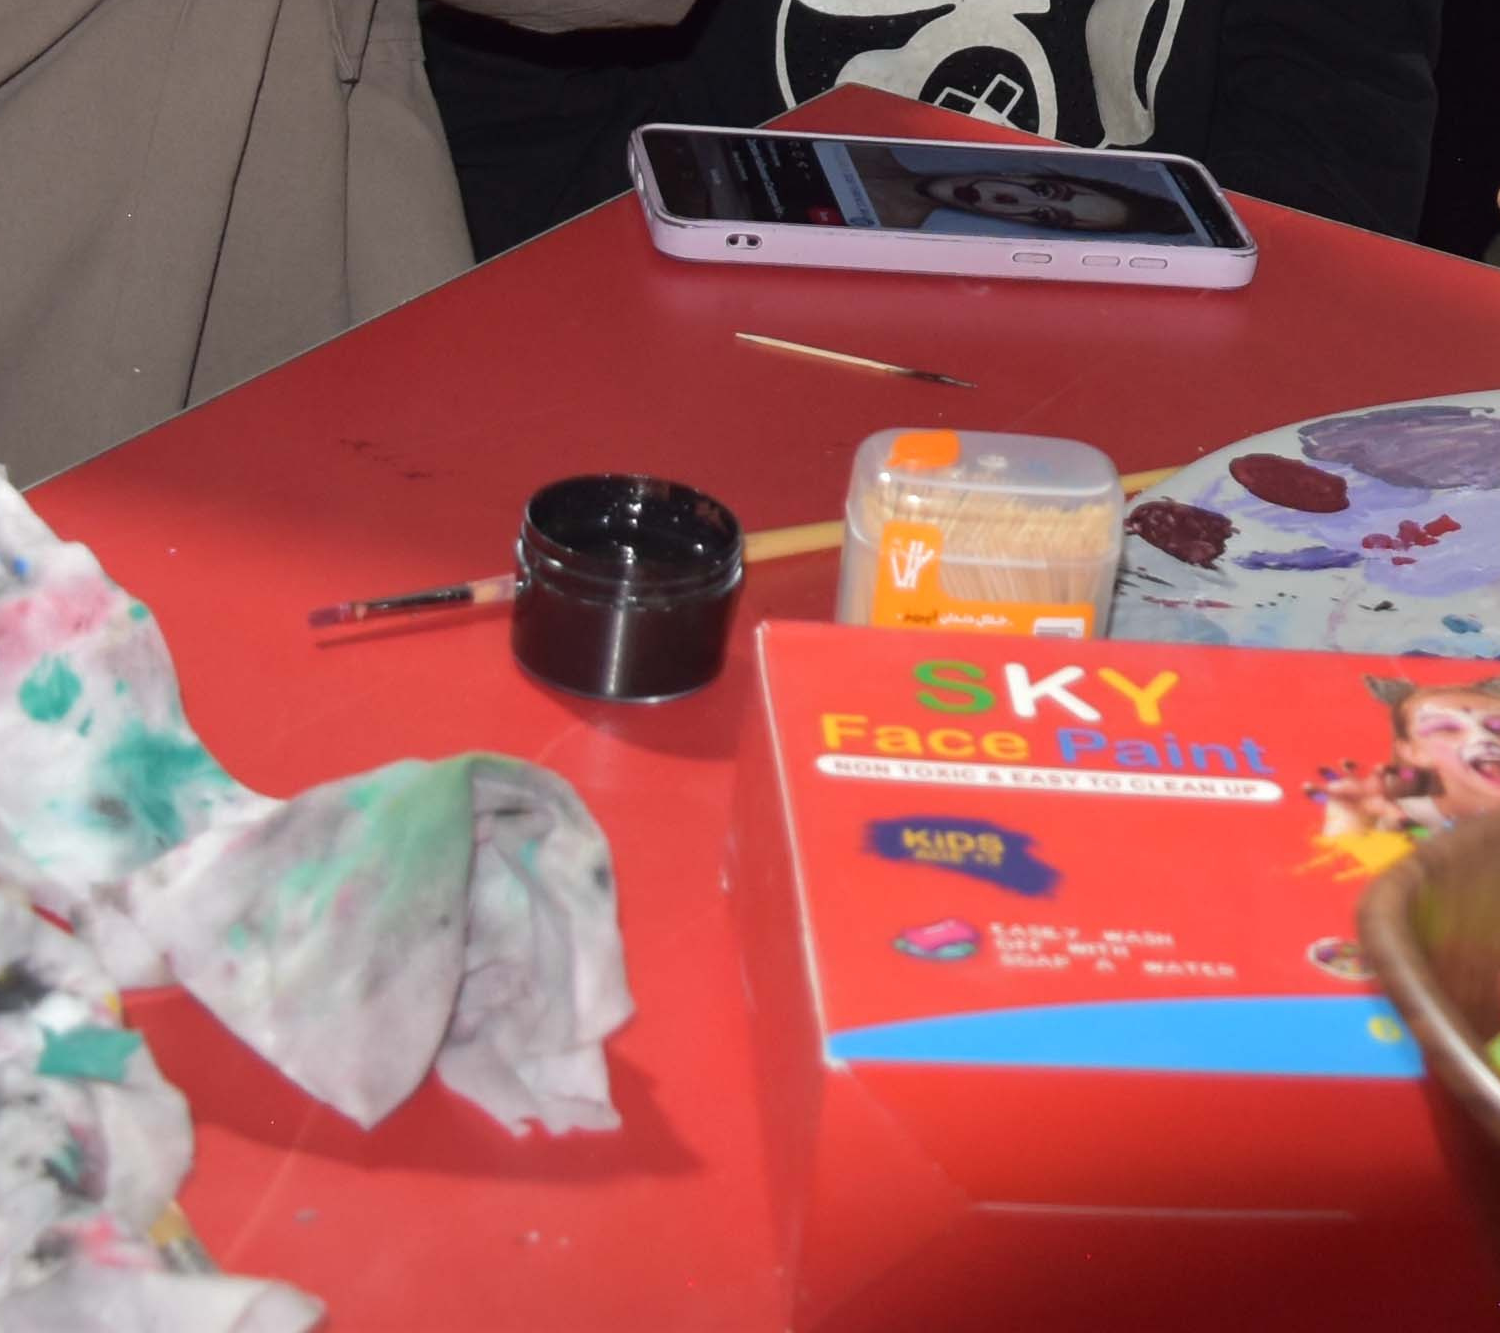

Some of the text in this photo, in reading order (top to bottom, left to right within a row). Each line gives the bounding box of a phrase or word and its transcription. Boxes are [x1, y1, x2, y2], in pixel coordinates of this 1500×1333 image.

[912, 660, 1179, 726] SKY
[820, 713, 1275, 775] Face Paint
[833, 759, 892, 777] NON
[899, 763, 979, 784] TOXIC
[1011, 770, 1080, 789] EASY
[1087, 775, 1122, 791] TO
[1129, 778, 1217, 796] CLEAN
[1225, 783, 1260, 797] UP
